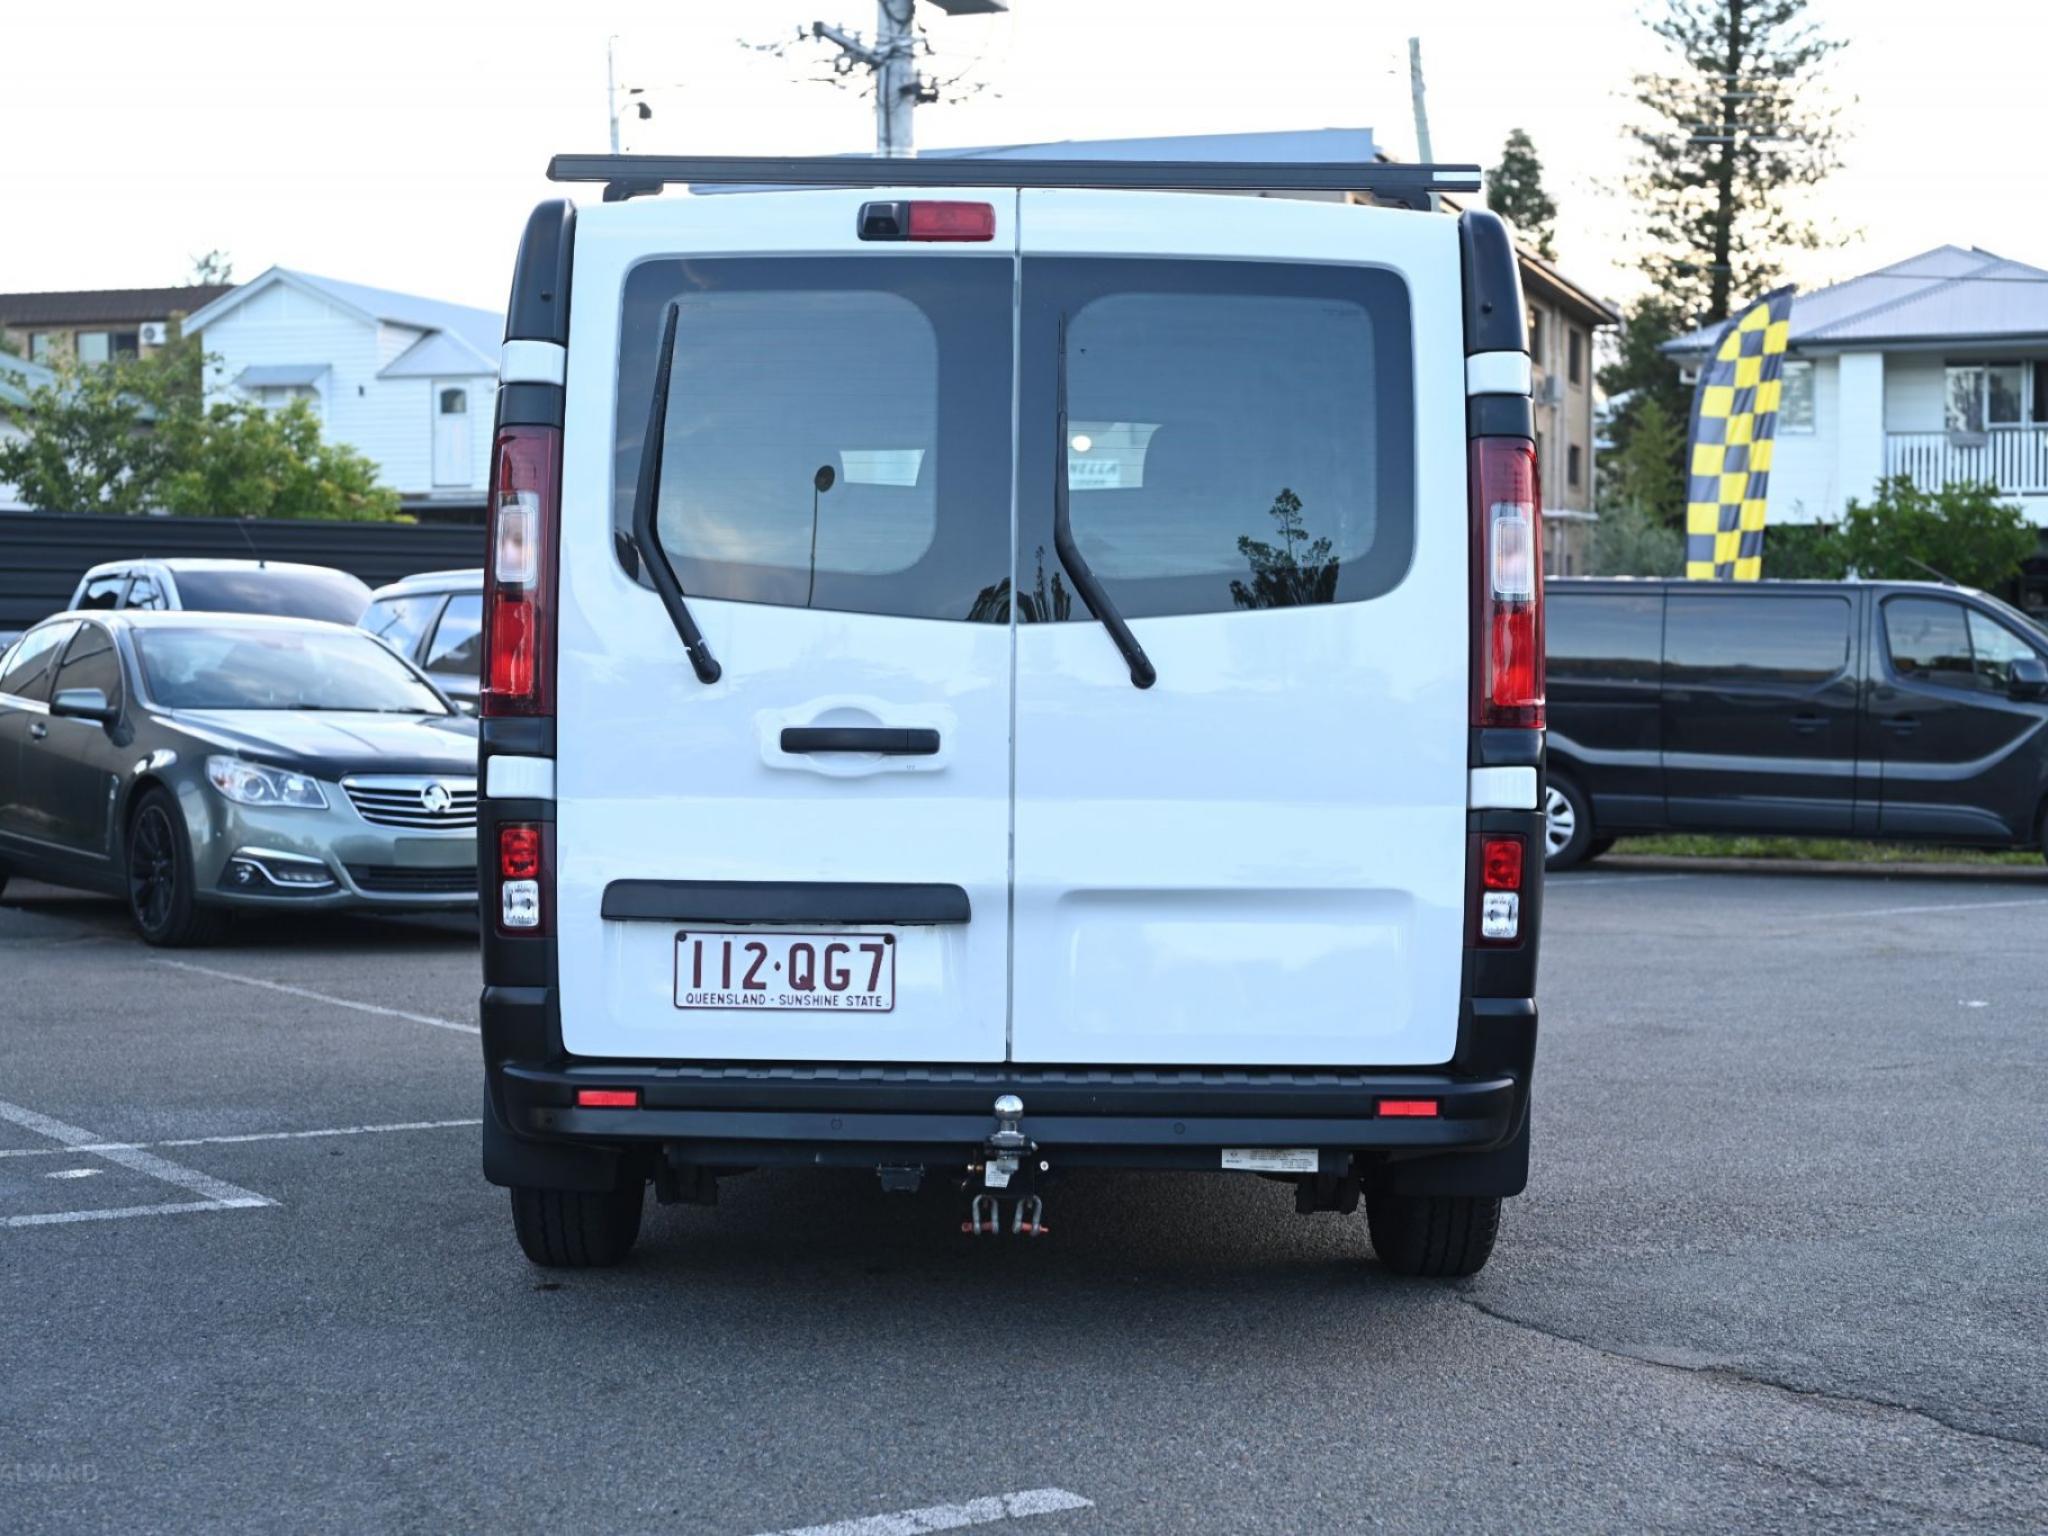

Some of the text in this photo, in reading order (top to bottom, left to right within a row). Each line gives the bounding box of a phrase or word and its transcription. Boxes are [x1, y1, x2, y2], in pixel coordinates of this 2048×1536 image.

[685, 992, 766, 1006] QUEENSLAND
[779, 994, 839, 1007] SUNSHINE
[846, 995, 883, 1008] STATE
